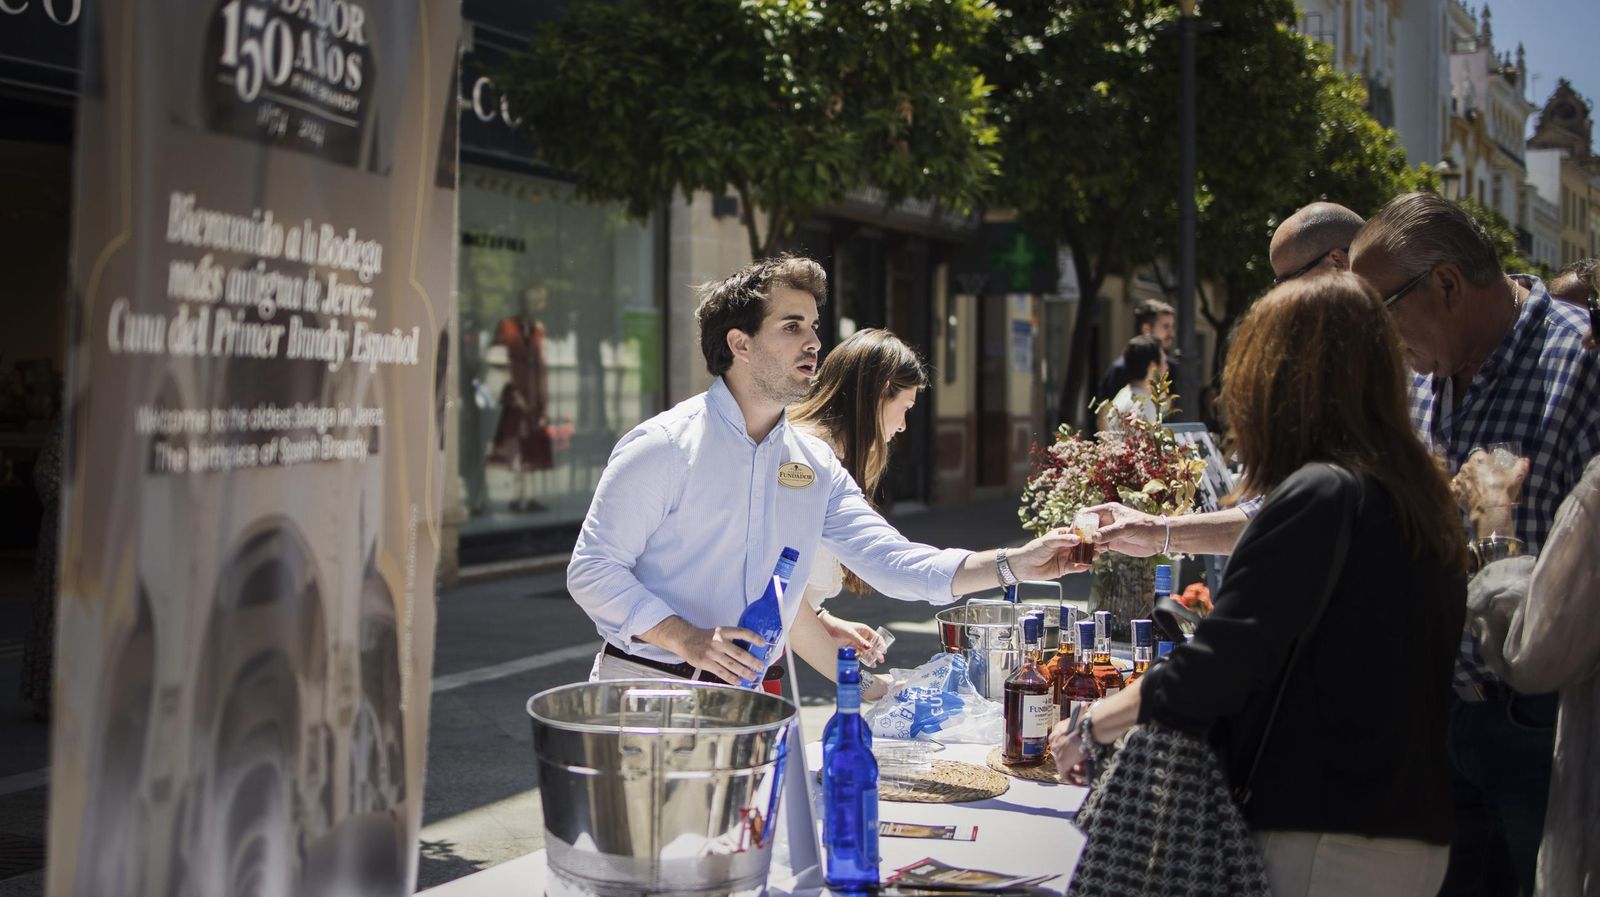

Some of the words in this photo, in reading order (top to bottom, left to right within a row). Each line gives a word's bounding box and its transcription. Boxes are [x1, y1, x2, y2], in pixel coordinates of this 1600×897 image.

[219, 0, 295, 103] 150
[166, 191, 284, 258] Bienvenido
[318, 222, 384, 283] Bodega
[167, 253, 225, 304] más
[225, 260, 303, 320] antigua
[107, 296, 167, 354] Cuna
[167, 303, 210, 356] del
[211, 307, 286, 358] Primer
[286, 314, 350, 373] Brandy
[350, 320, 420, 374] Español
[779, 471, 813, 480] FUNDADOR
